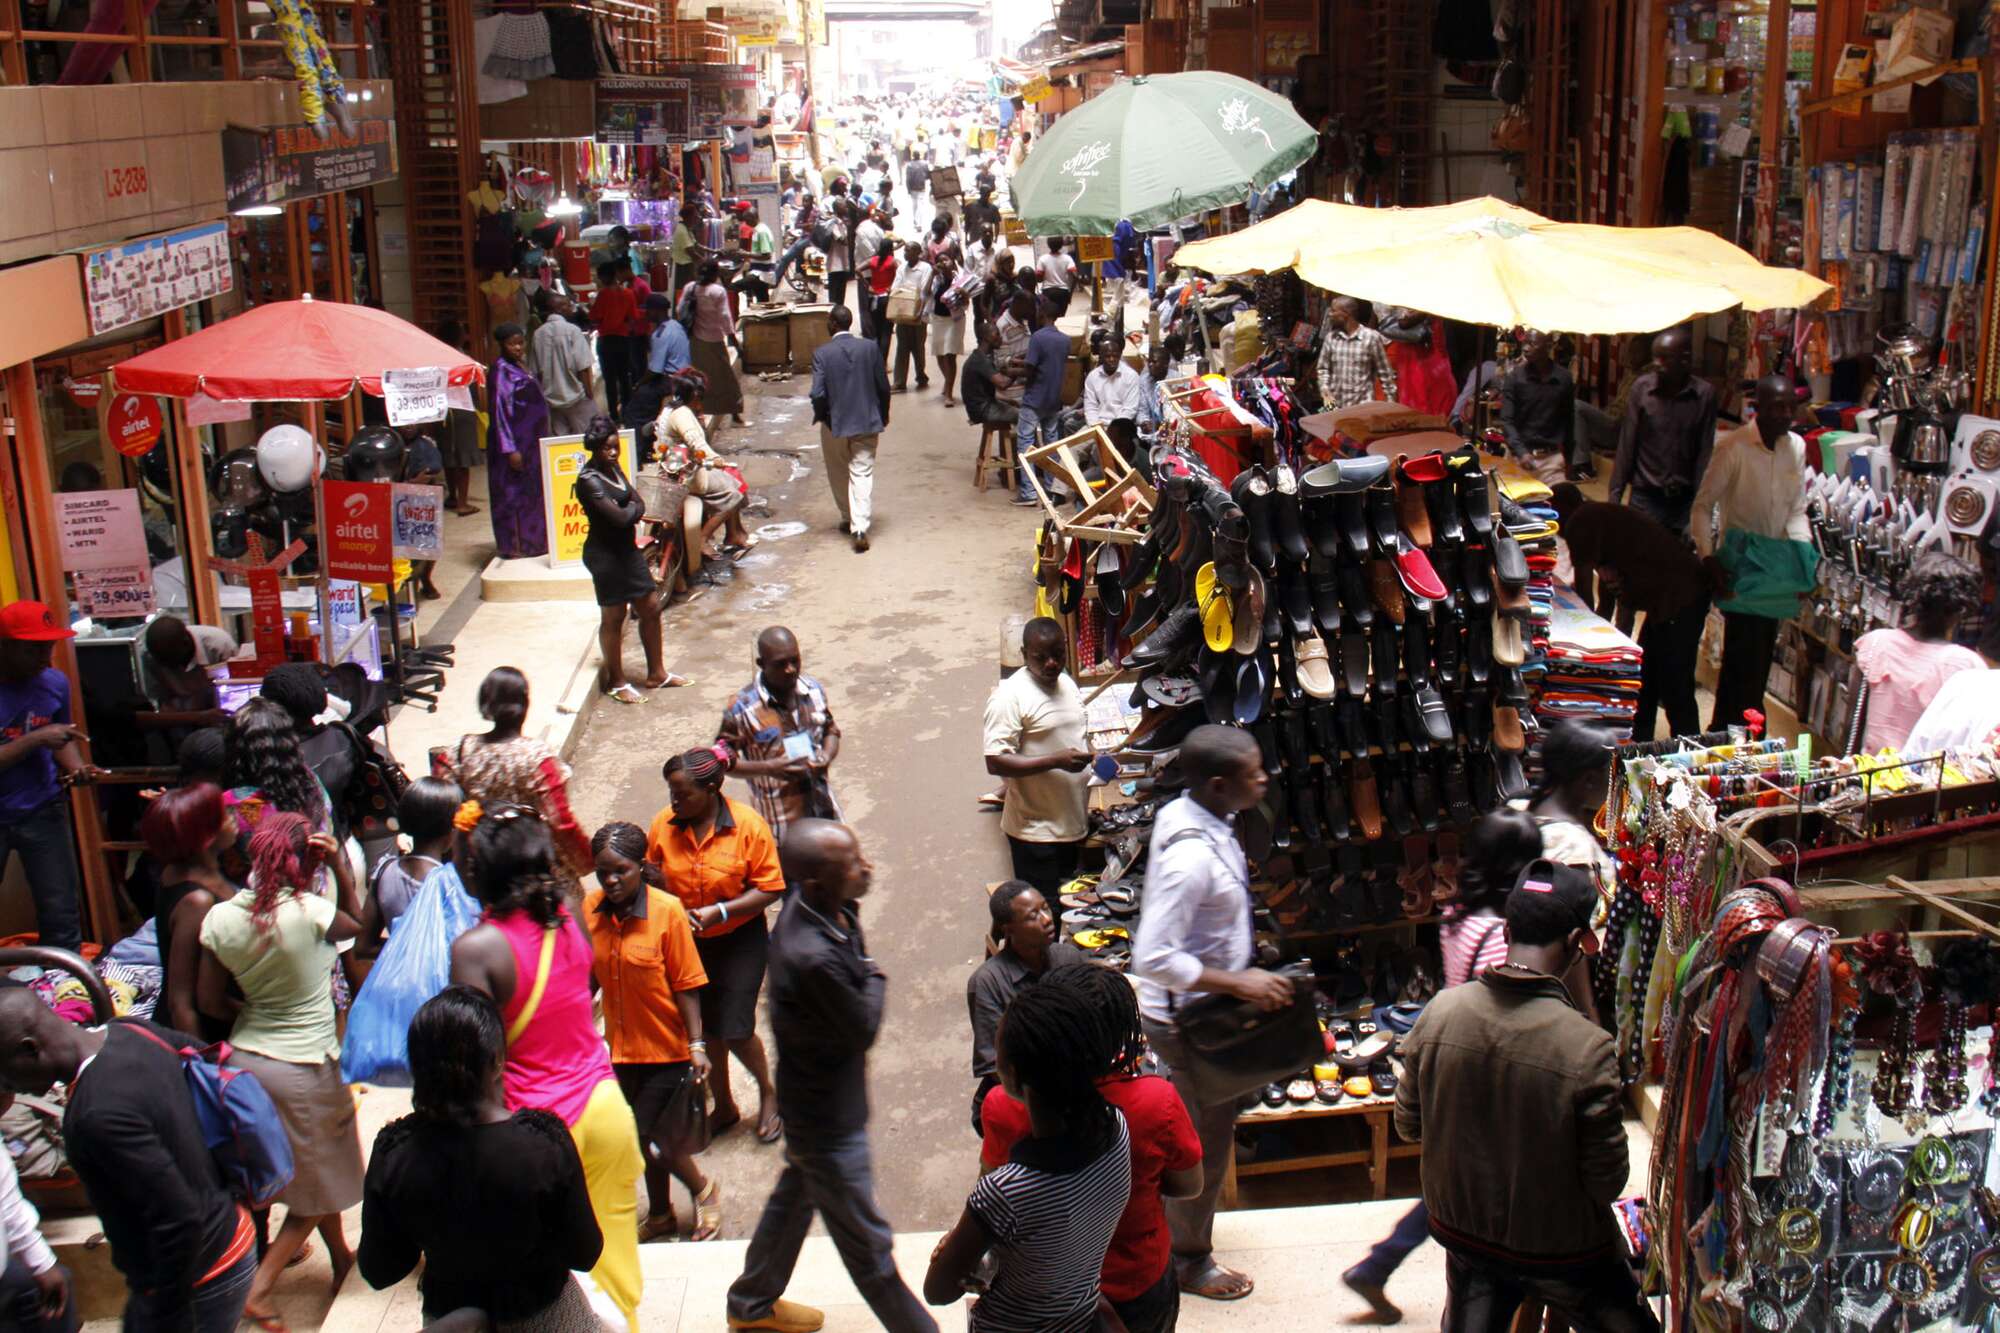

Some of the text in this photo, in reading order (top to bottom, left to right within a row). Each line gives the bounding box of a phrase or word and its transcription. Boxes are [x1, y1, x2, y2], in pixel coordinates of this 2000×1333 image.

[122, 416, 151, 436] airtel
[64, 500, 110, 510] SIMCARD
[71, 516, 106, 525] AIRTEL
[72, 528, 105, 537] WARID
[336, 522, 379, 540] airtel
[75, 540, 97, 548] MTN
[339, 542, 376, 554] money
[330, 561, 366, 571] available
[328, 585, 355, 601] warid
[335, 602, 355, 622] pesa
